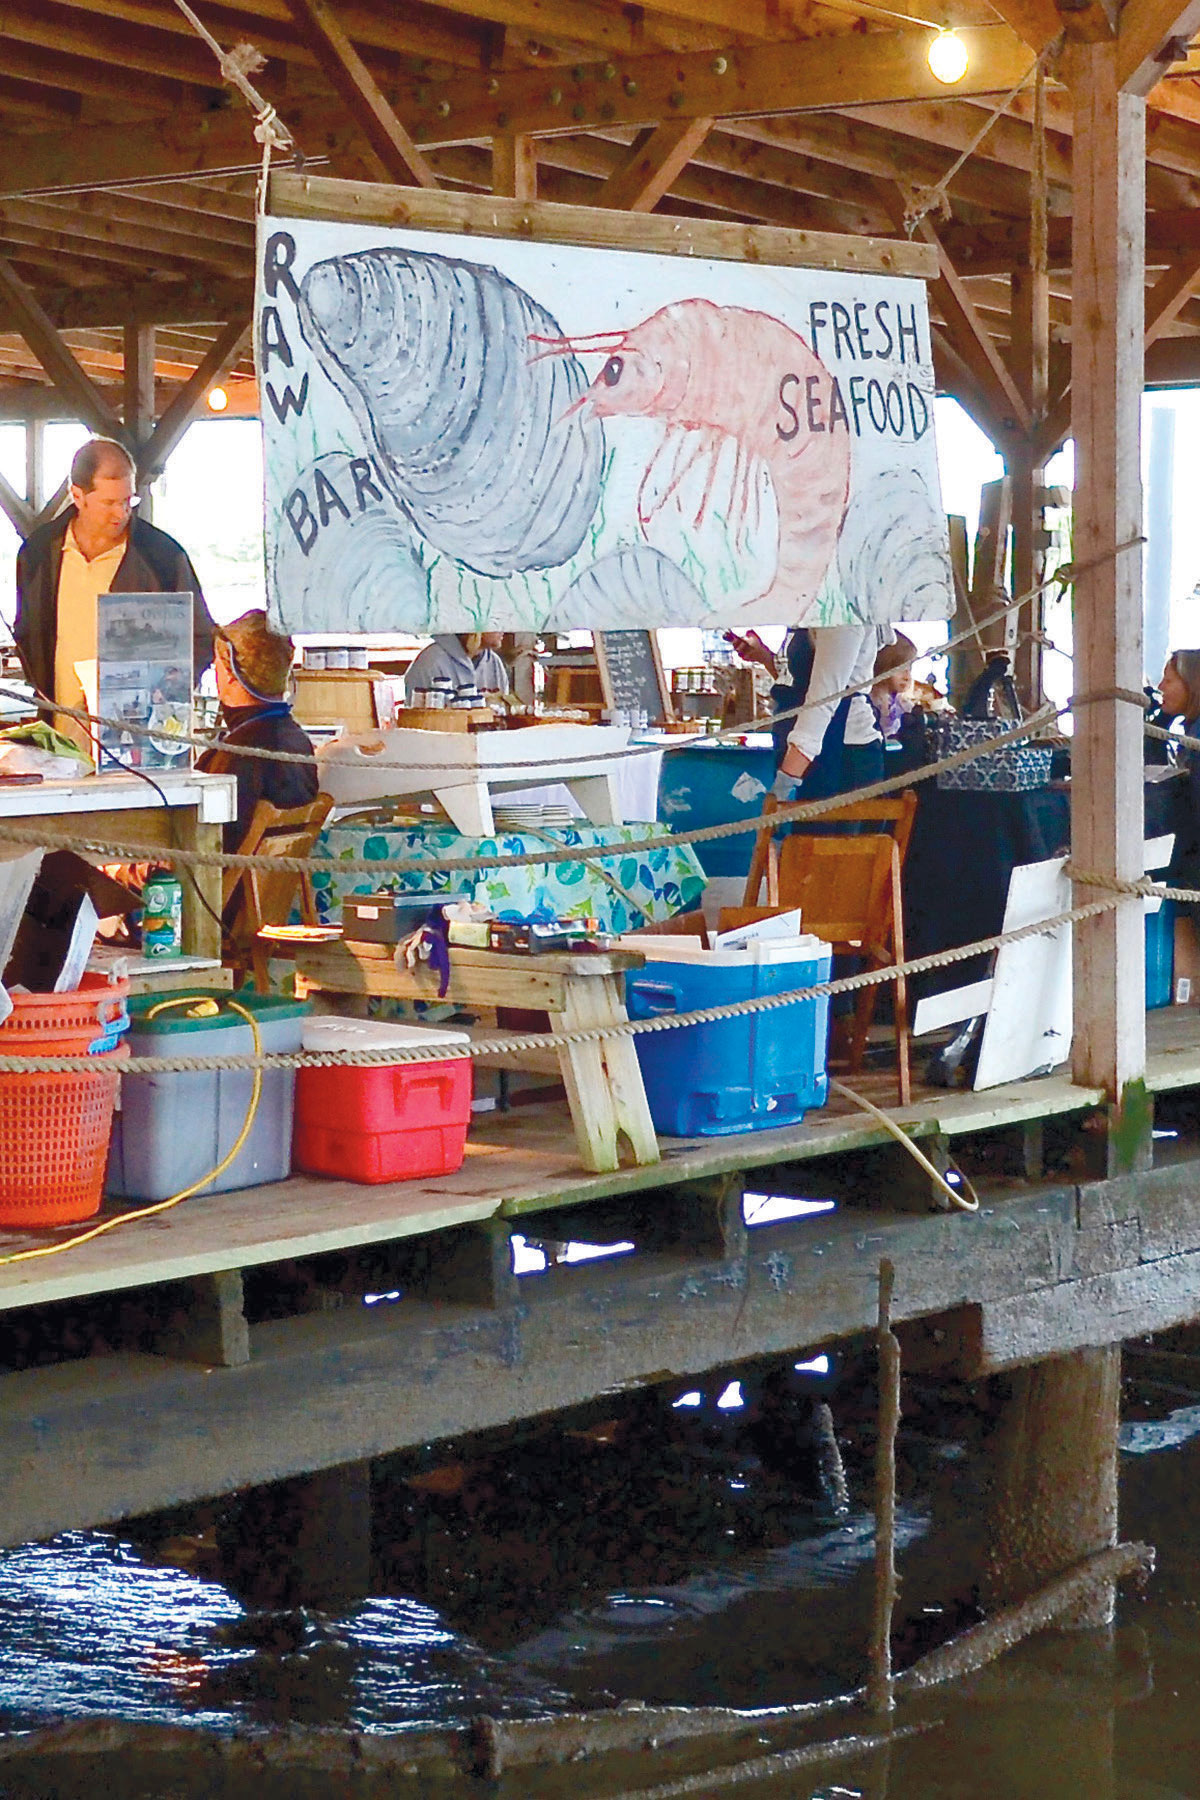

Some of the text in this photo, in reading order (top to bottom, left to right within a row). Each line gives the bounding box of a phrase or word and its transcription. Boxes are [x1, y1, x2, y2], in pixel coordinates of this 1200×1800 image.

[261, 231, 309, 423] RAW
[809, 300, 920, 364] FRESH
[776, 373, 928, 442] SEAFOOD
[283, 457, 383, 557] BAR
